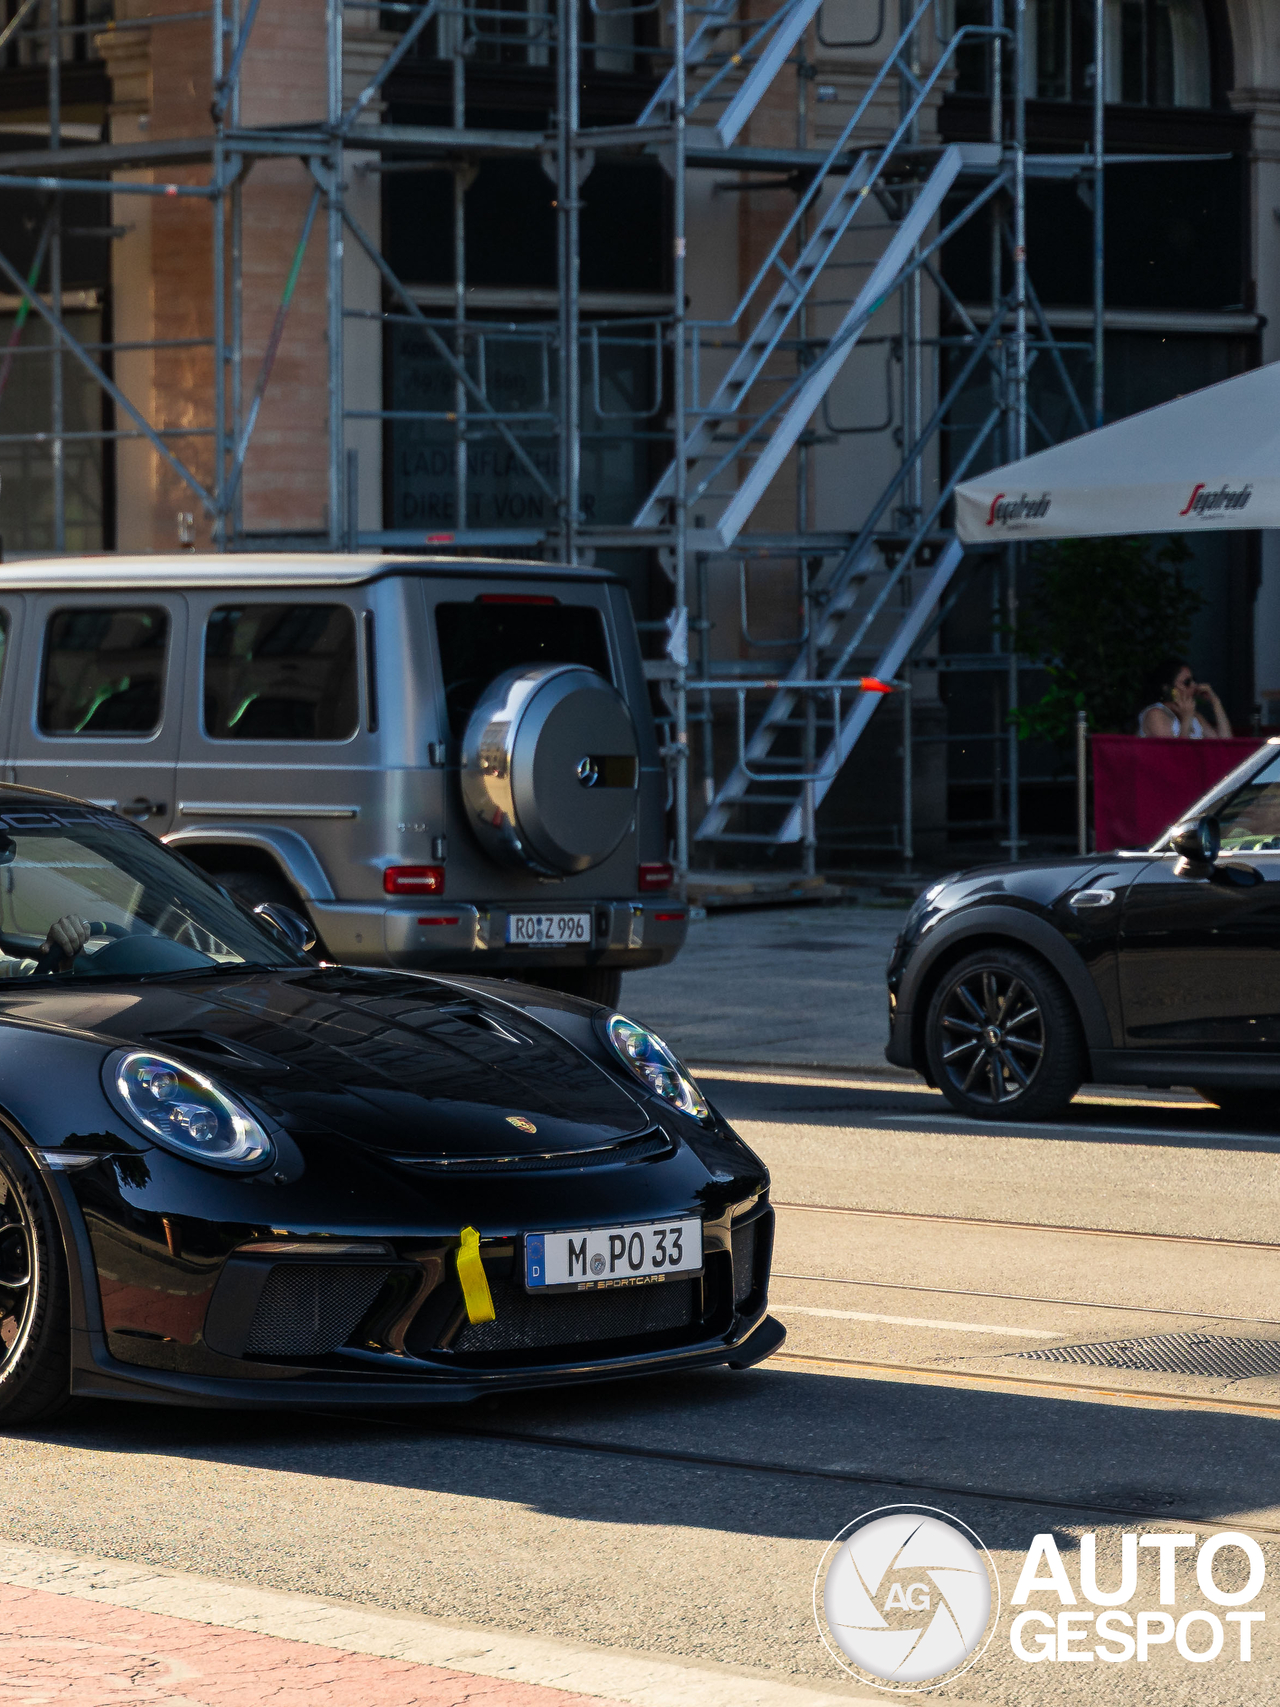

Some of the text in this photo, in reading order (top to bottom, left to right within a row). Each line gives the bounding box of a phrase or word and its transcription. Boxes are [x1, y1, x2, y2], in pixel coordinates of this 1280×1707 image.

[402, 492, 483, 519] DIRET
[985, 490, 1052, 526] Segafredo
[1178, 482, 1254, 517] Segafredo
[515, 916, 585, 939] RO Z 996
[567, 1226, 683, 1277] M PO 33
[533, 1265, 541, 1277] D
[597, 1273, 667, 1289] SPORTCARS
